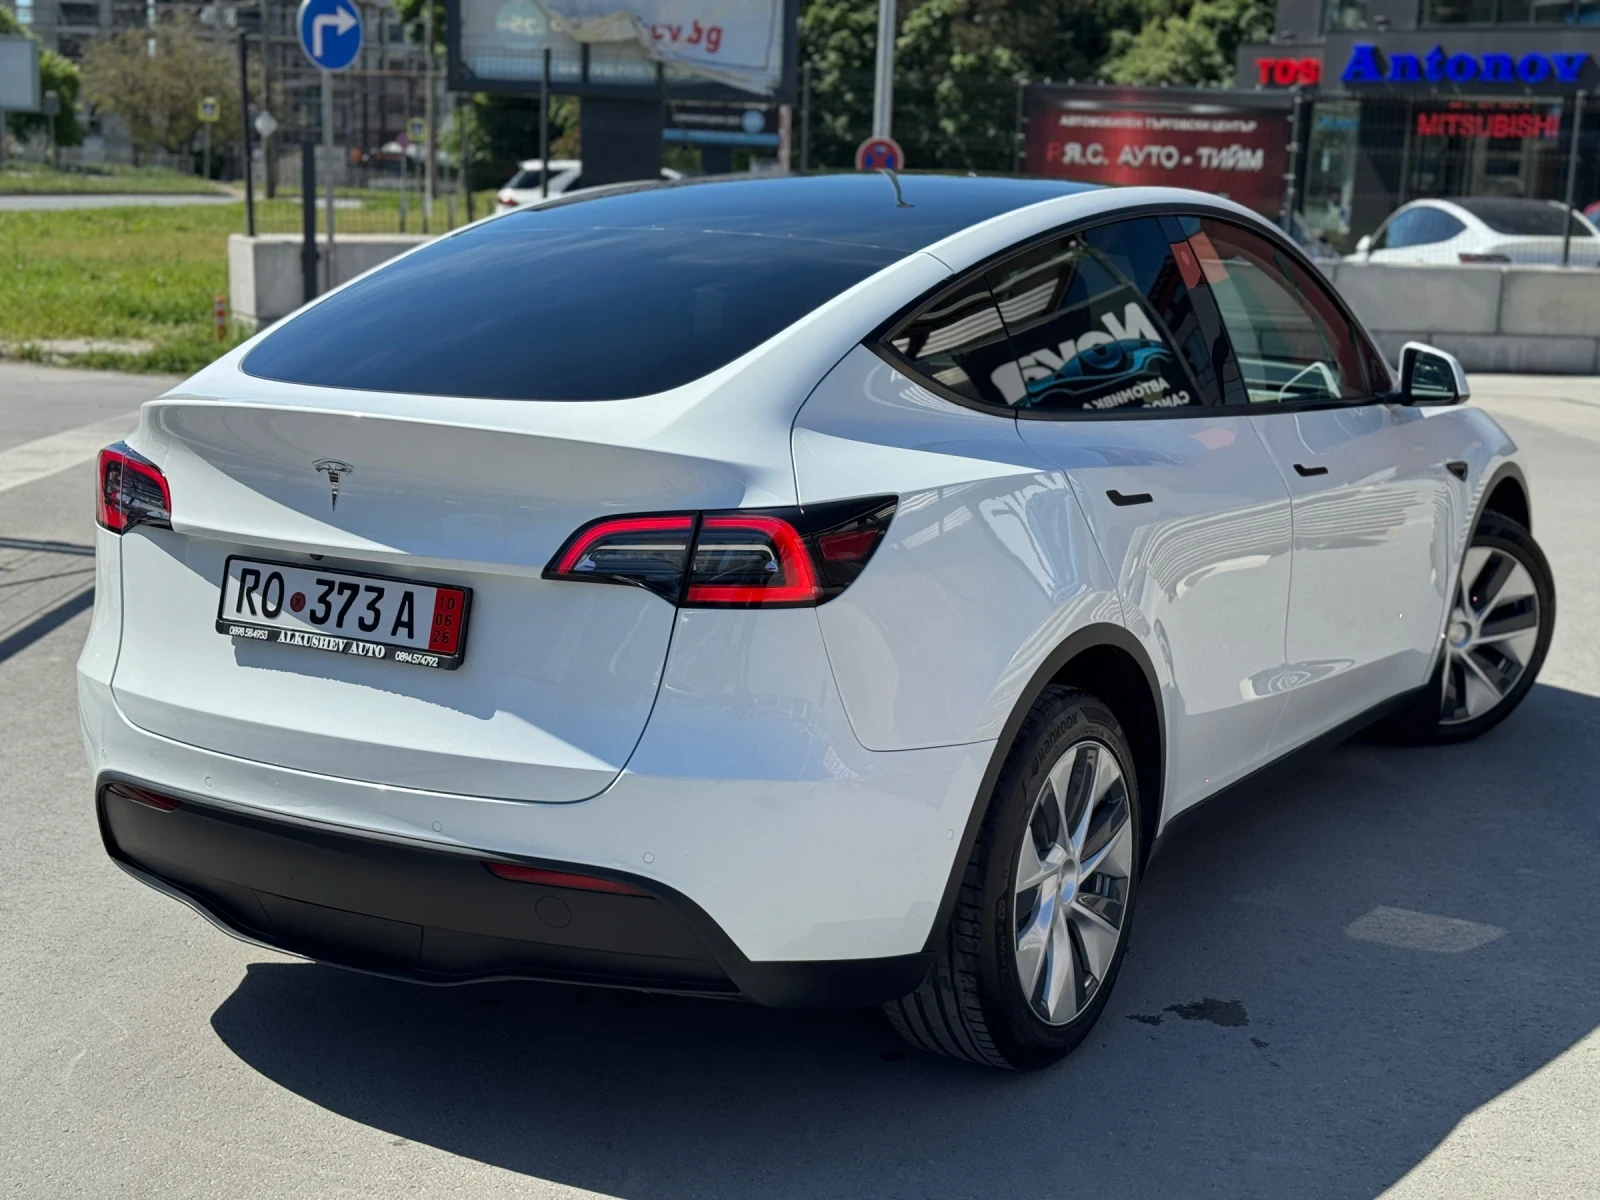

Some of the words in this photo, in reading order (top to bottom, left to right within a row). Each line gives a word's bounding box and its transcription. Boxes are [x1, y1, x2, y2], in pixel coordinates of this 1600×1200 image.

[1255, 57, 1322, 86] TOS
[1341, 44, 1590, 84] Antonov
[1416, 113, 1560, 138] MITSUBISHI
[1117, 144, 1180, 168] АУТО
[236, 568, 285, 619] RO
[309, 578, 385, 633] 373
[391, 591, 415, 639] A
[440, 596, 456, 611] 10
[435, 612, 453, 628] 06
[277, 630, 348, 653] ALKUSHEV
[348, 641, 385, 659] AUTO
[432, 630, 450, 645] 26
